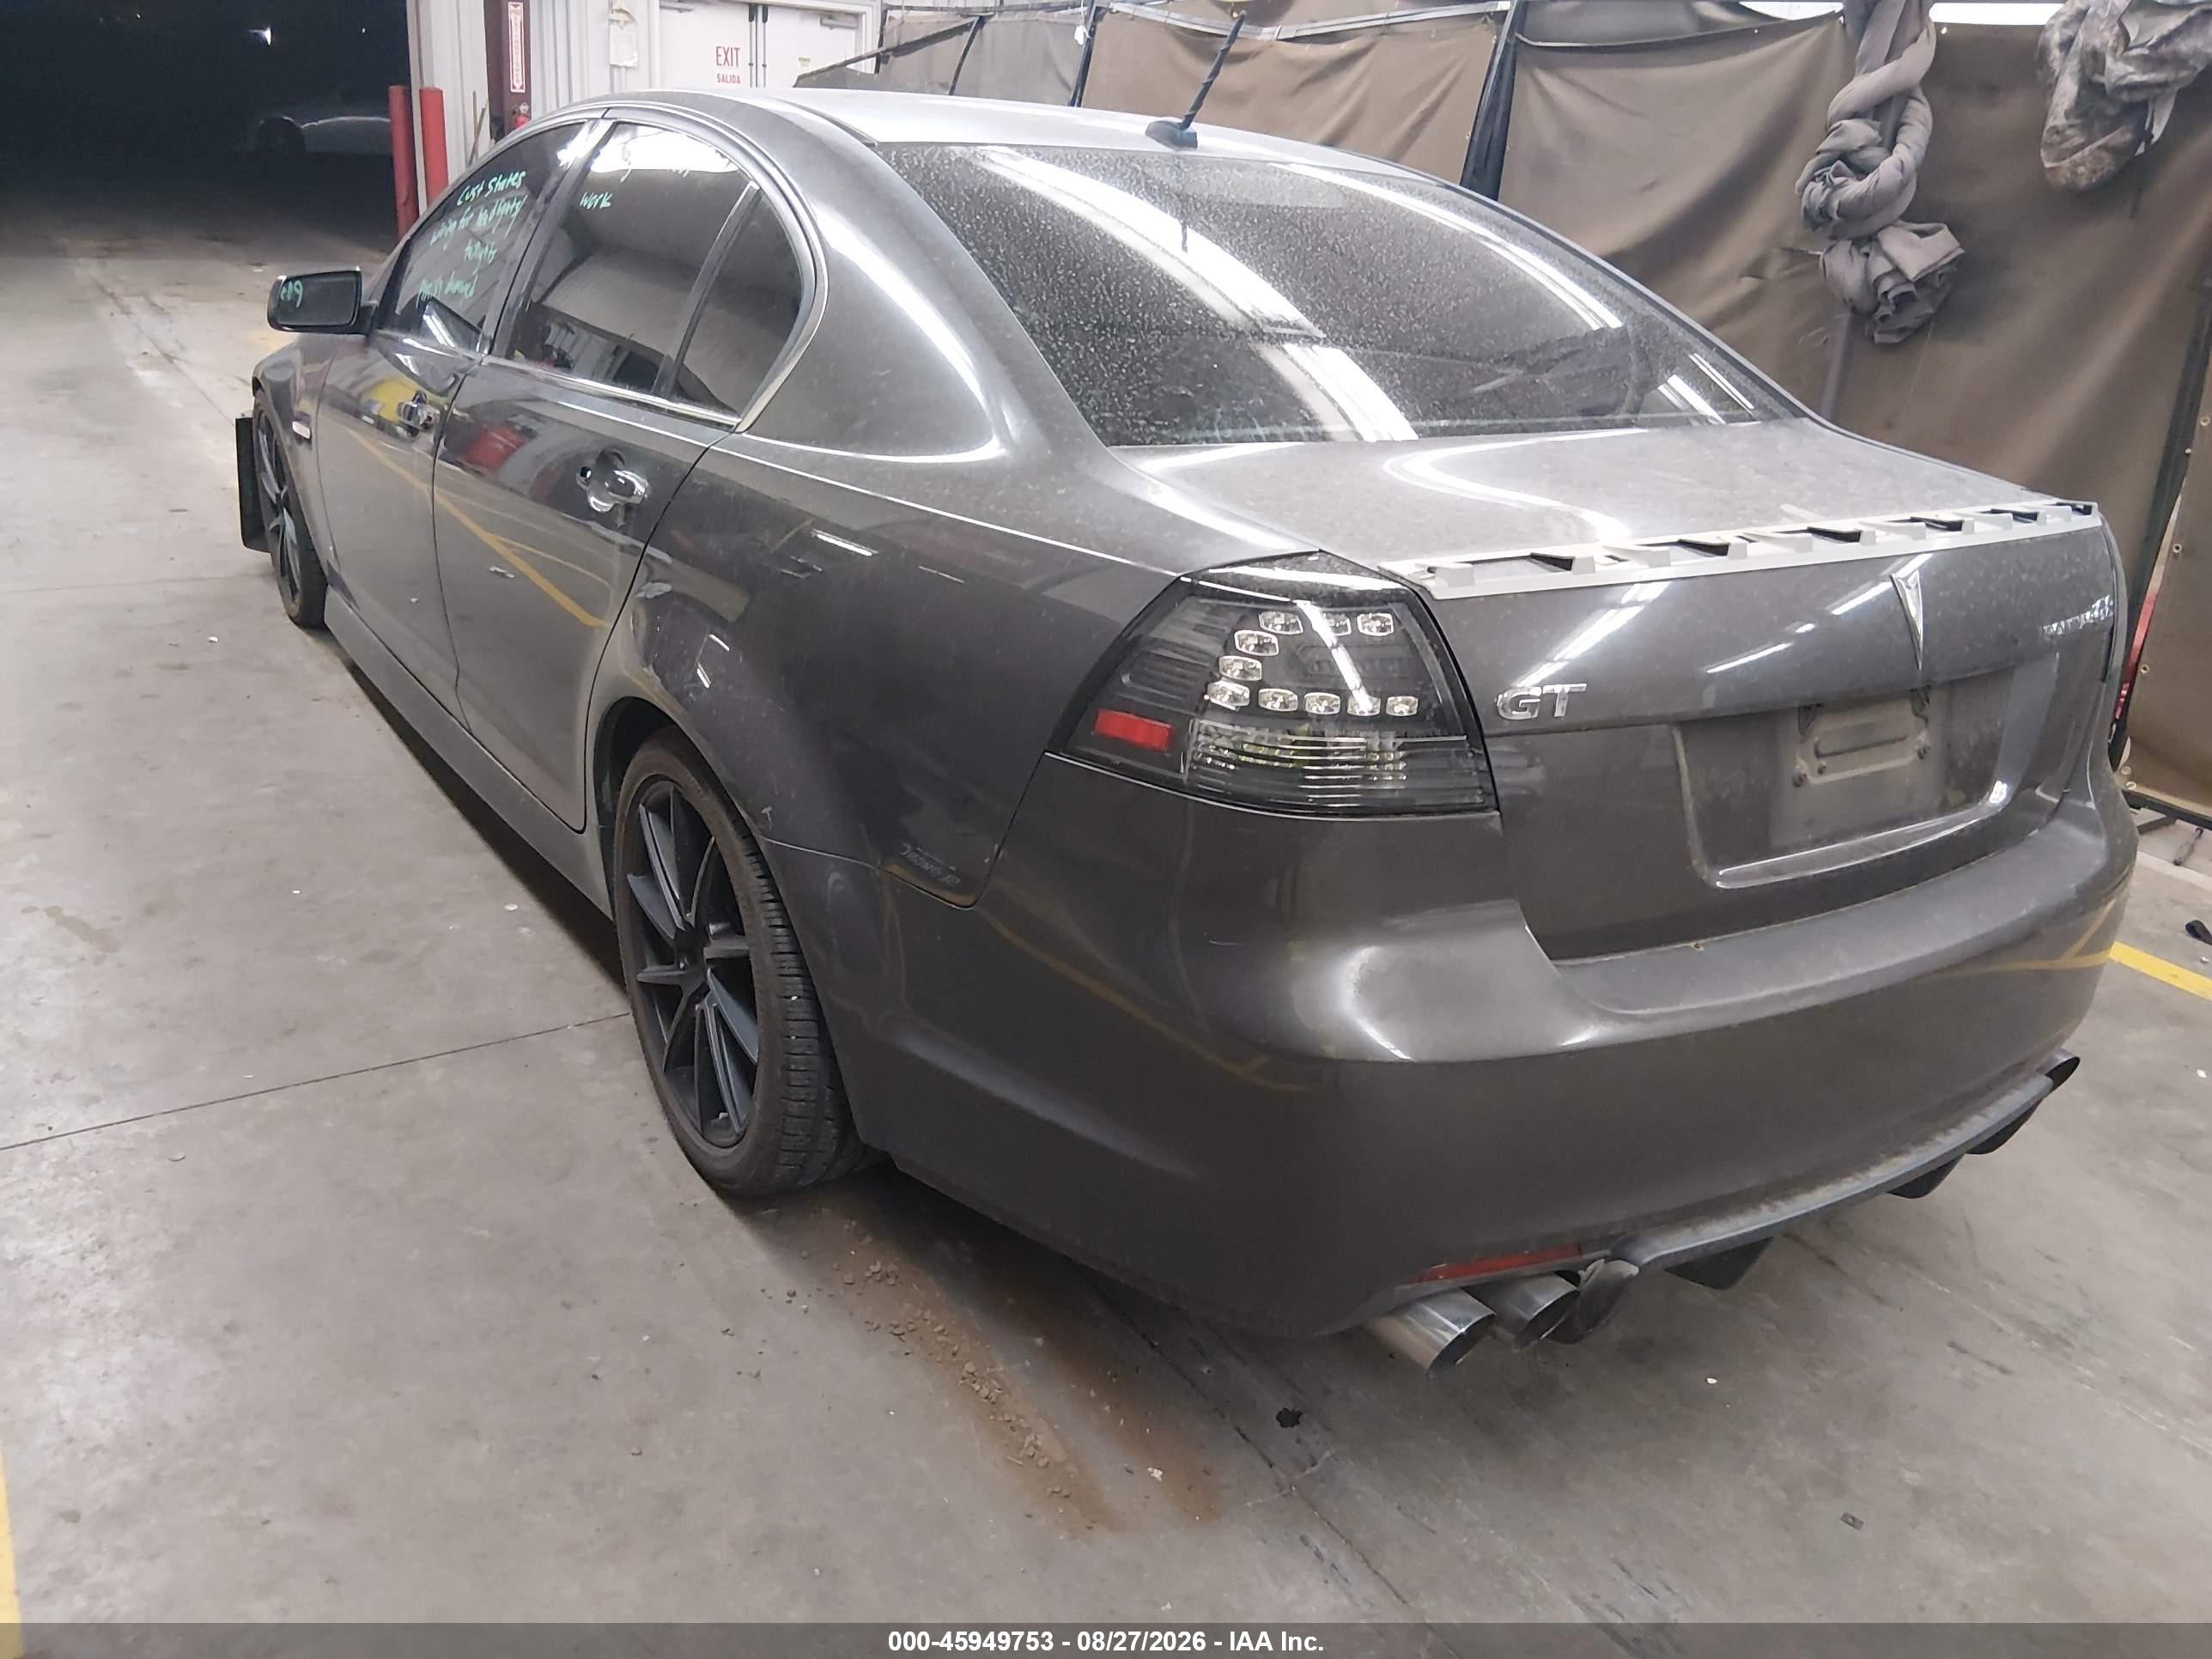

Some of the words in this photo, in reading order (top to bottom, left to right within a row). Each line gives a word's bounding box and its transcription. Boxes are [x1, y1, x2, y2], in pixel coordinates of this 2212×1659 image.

[715, 46, 741, 68] EXIT
[716, 73, 741, 84] SALIDA
[485, 171, 526, 198] States
[1497, 683, 1587, 720] GT
